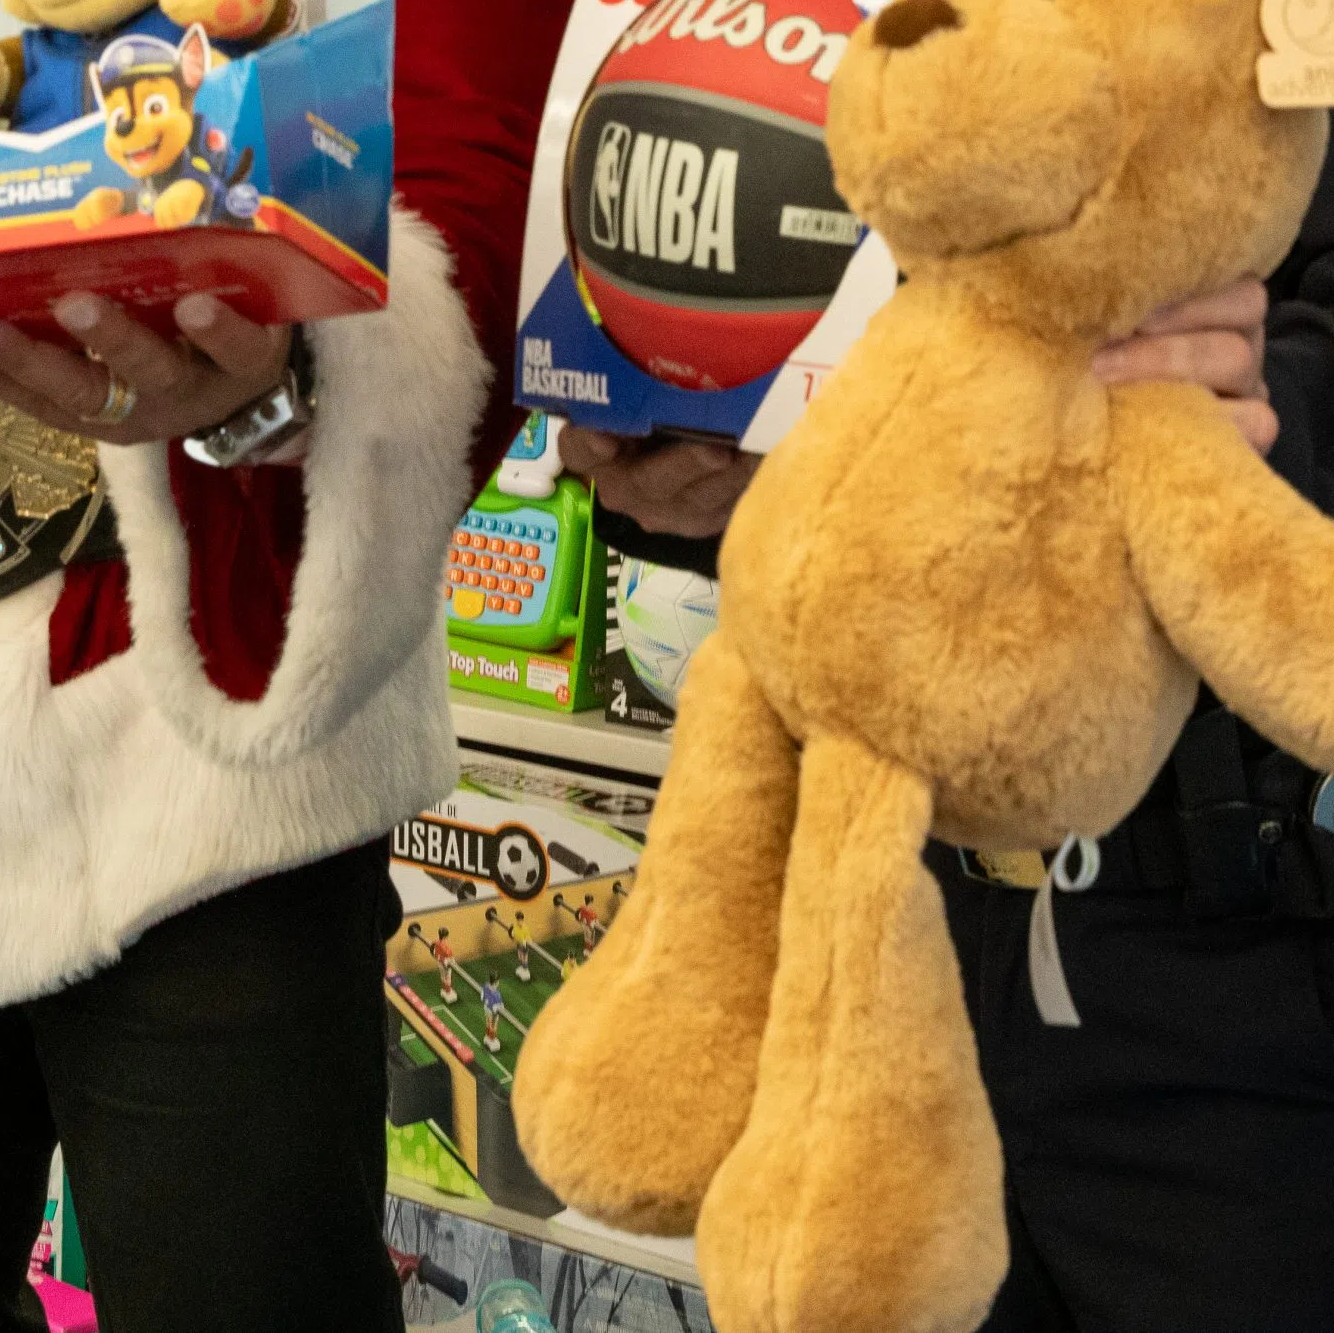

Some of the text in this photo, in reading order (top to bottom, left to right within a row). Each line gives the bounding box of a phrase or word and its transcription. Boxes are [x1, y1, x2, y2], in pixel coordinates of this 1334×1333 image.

[623, 133, 739, 273] NBA
[523, 338, 551, 369] NBA
[522, 369, 610, 406] BASKETBALL
[450, 650, 475, 677] Top
[478, 656, 520, 684] Touch
[610, 691, 628, 719] 4
